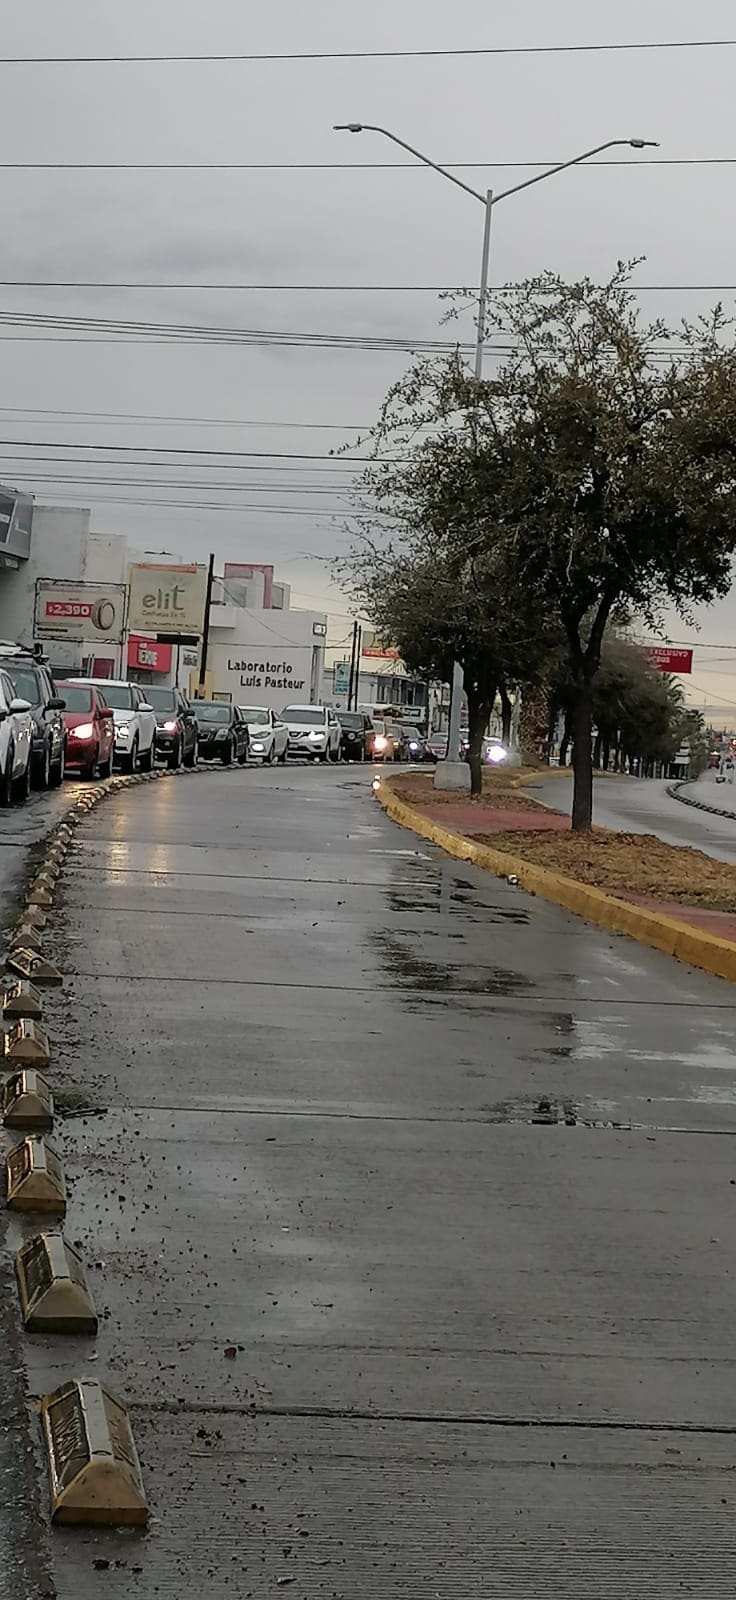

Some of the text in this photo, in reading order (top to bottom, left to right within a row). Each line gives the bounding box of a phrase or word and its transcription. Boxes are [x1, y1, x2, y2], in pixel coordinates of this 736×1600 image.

[142, 584, 185, 610] elit
[49, 603, 90, 616] $2,390
[228, 659, 293, 674] Laboratorio
[240, 675, 306, 690] Luis Pasteur
